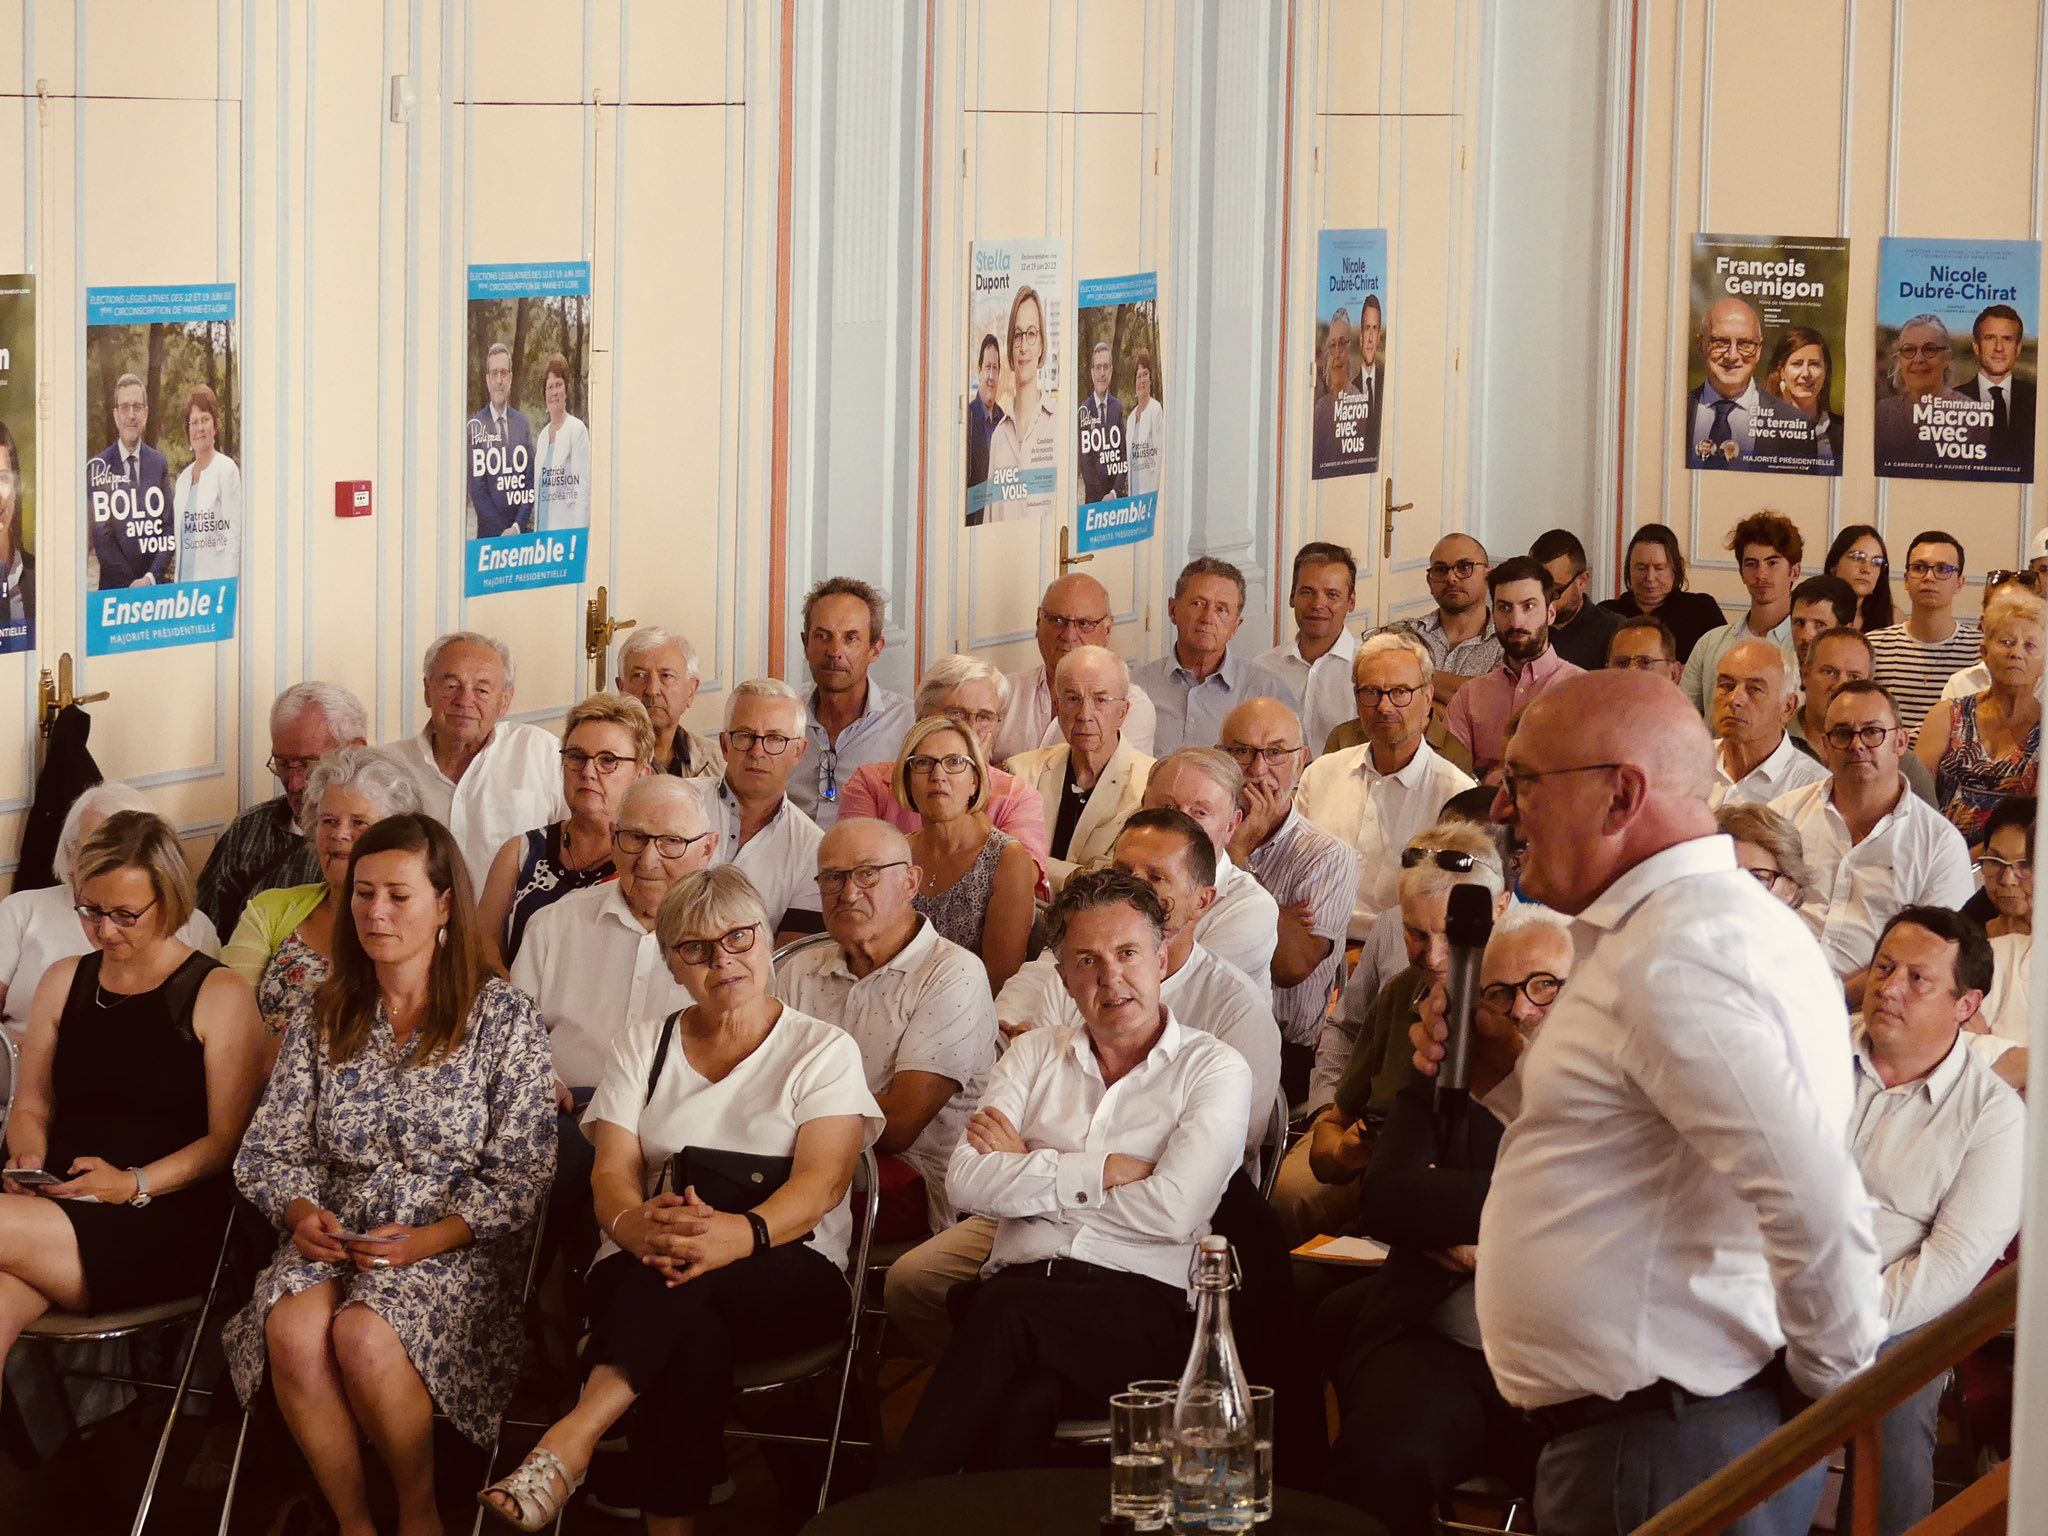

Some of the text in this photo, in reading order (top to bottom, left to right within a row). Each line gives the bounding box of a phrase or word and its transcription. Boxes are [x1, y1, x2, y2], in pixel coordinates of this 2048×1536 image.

[976, 249, 1011, 272] Stella
[1045, 262, 1056, 270] 2022
[1343, 257, 1366, 274] Nicole
[1716, 256, 1806, 279] François
[1329, 274, 1379, 292] Dubré-Chirat
[1930, 266, 1988, 283] Nicole
[976, 274, 1010, 294] Dupont
[1725, 276, 1824, 300] Gernigon
[1900, 282, 2017, 301] Dubré-Chirat
[173, 305, 182, 314] DE
[1338, 390, 1344, 400] et
[1921, 393, 1994, 411] et Emmanuel
[1334, 401, 1369, 421] Macron
[1749, 405, 1774, 417] Élus
[1913, 404, 1994, 427] Macron
[1335, 421, 1357, 438] avec
[1749, 417, 1807, 429] de terrain
[467, 419, 502, 449] Philippe
[1082, 425, 1120, 454] BOLO
[1748, 428, 1815, 440] avec vous !
[1918, 425, 1968, 443] avec
[1342, 437, 1364, 454] vous
[1935, 443, 1987, 460] vous
[473, 445, 528, 477] BOLO
[1100, 450, 1120, 464] avec
[1743, 455, 1835, 466] MAJORITÉ PRÉSIDENTIELLE
[86, 458, 132, 490] Philippe
[542, 466, 565, 477] Patricia
[994, 468, 1019, 485] avec
[1107, 461, 1128, 476] vous
[1973, 465, 2021, 473] PRÉSIDENTIELLE
[497, 475, 526, 491] avec
[542, 475, 580, 487] MAUSSION
[507, 489, 535, 506] vous
[1002, 483, 1028, 500] vous
[93, 486, 165, 522] BOLO
[184, 509, 215, 522] Patricia
[1086, 497, 1153, 531] Ensemble !
[127, 519, 163, 538] avec
[184, 520, 230, 534] MAUSSION
[140, 536, 176, 554] vous
[185, 537, 227, 551] Suppléante
[478, 535, 577, 572] Ensemble !
[515, 569, 568, 583] PRÉSIDENTIELLE
[102, 586, 226, 627] Ensemble !
[110, 624, 216, 646] MAJORITÉ PRÉSIDENTIELLE
